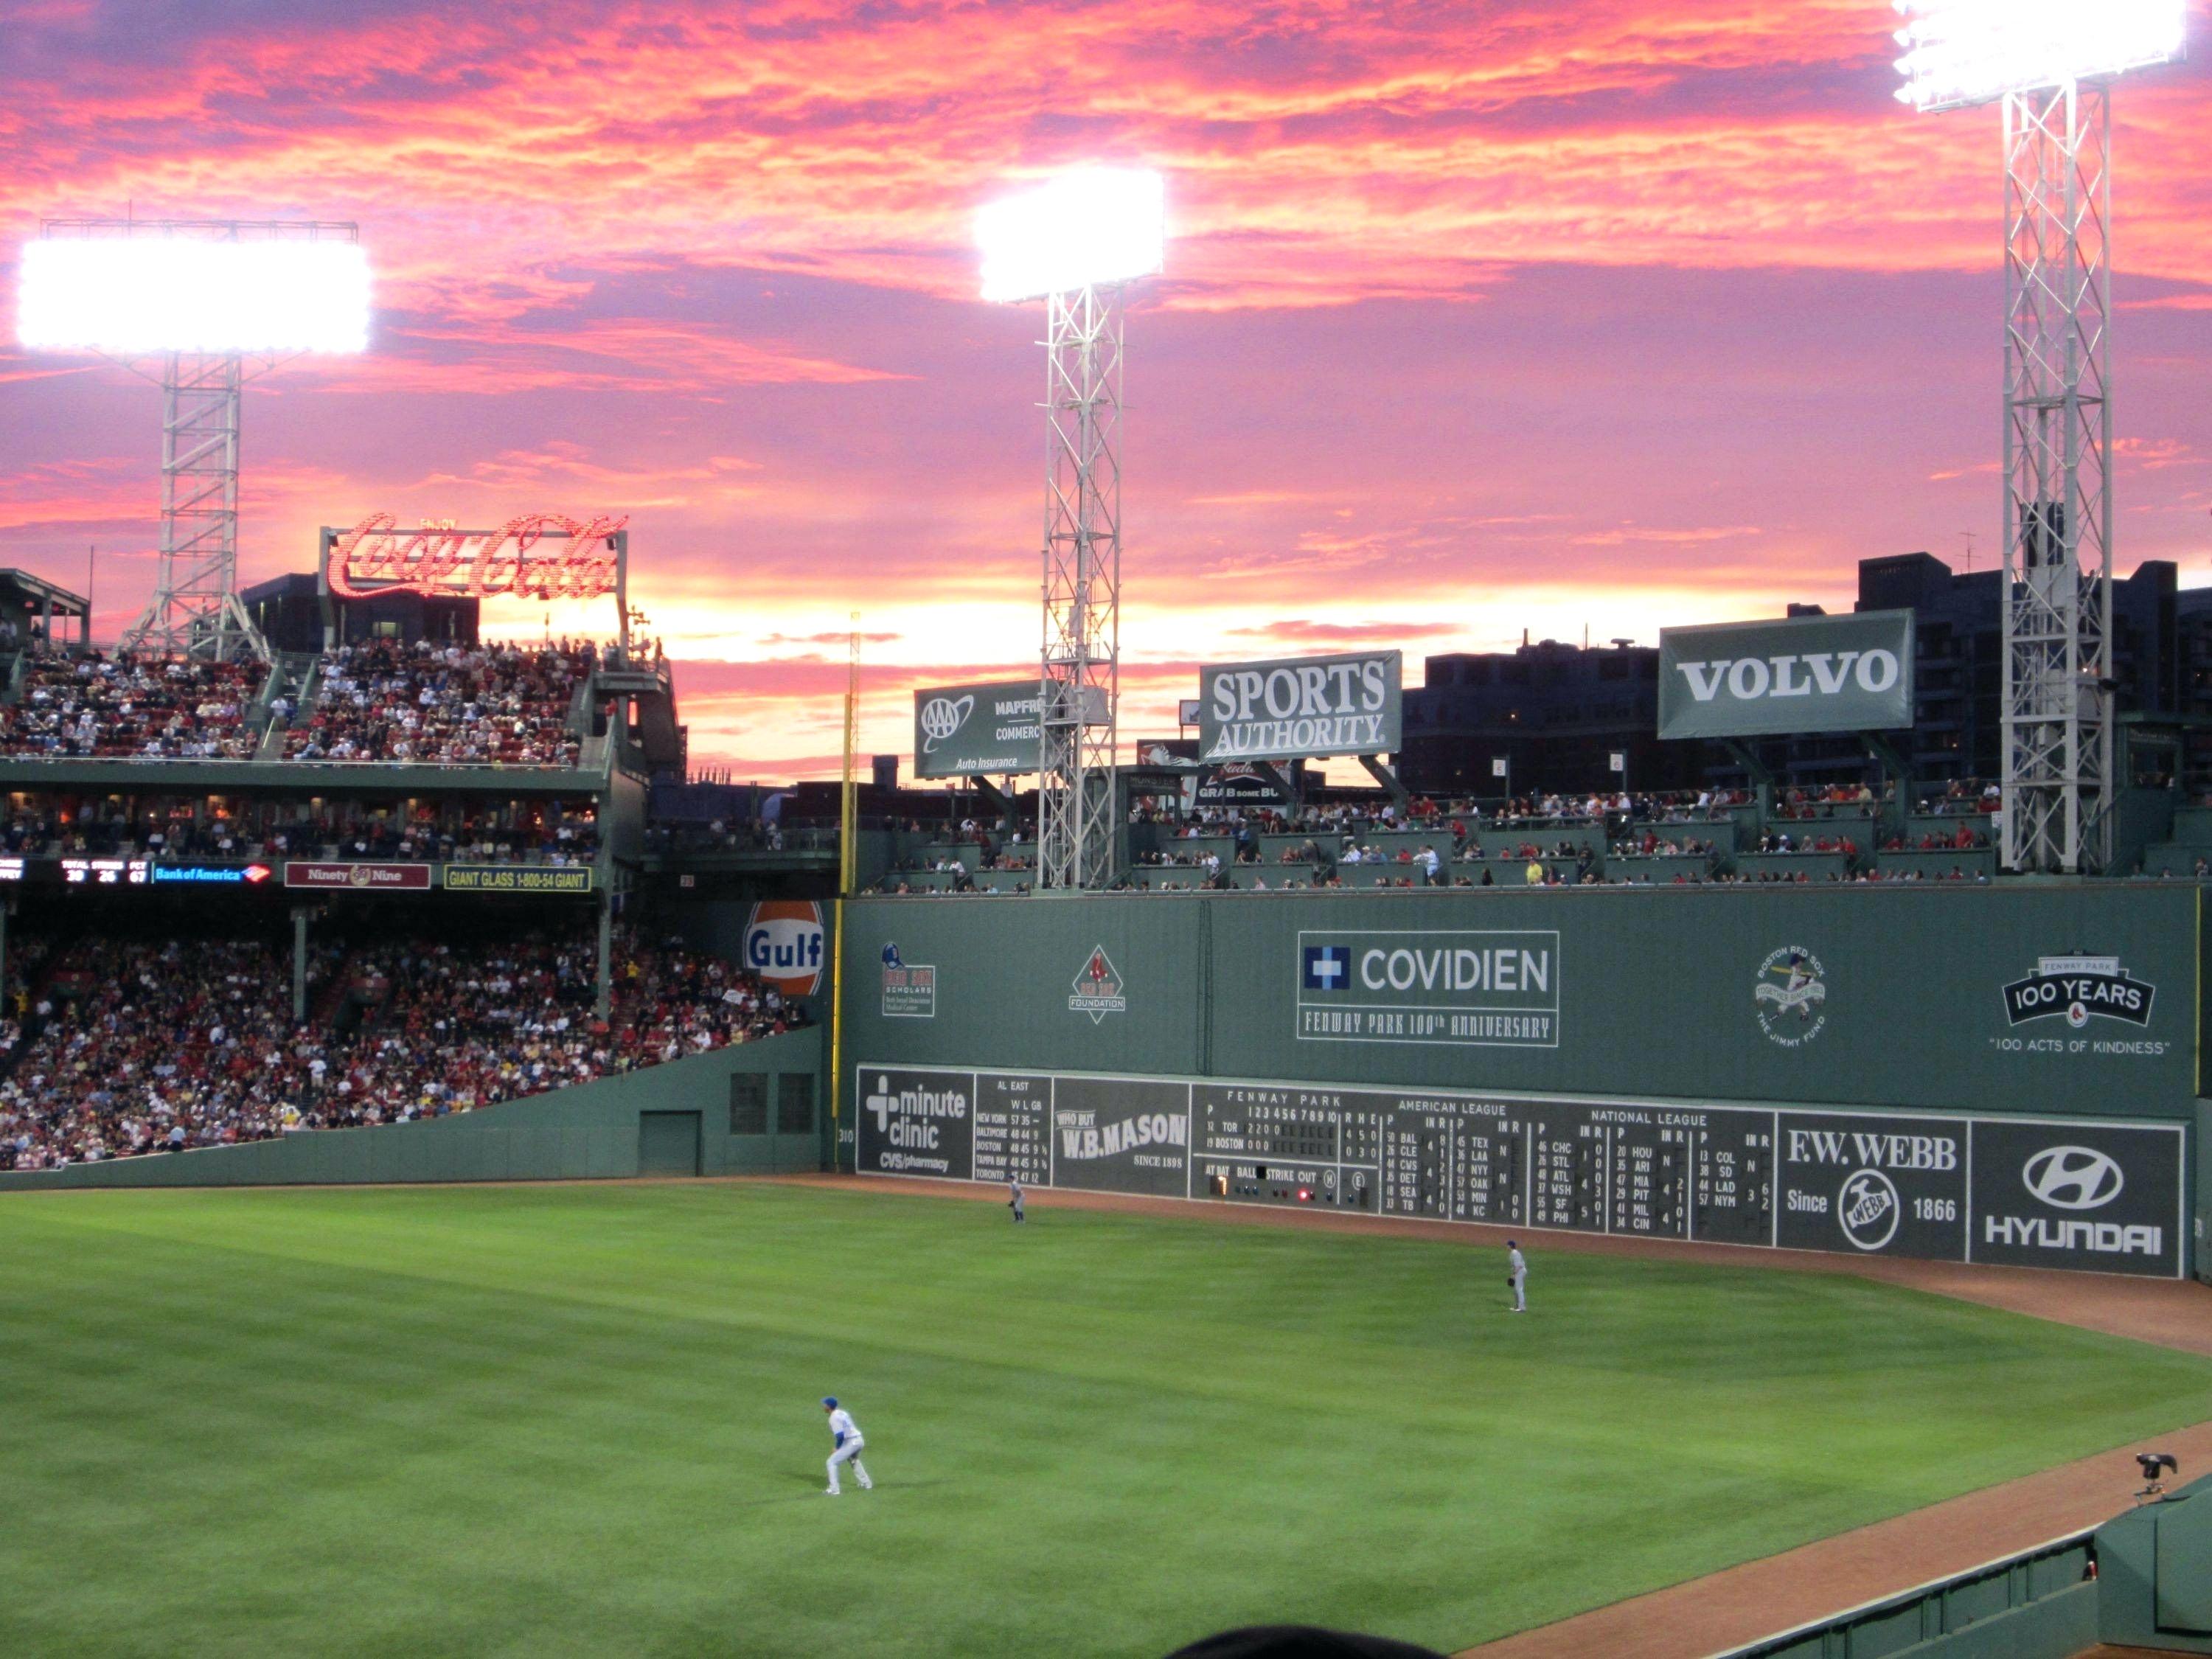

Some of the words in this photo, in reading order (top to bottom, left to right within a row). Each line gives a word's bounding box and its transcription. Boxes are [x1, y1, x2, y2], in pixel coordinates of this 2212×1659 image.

[420, 518, 458, 530] ENJOY
[327, 512, 628, 599] Coca-Cola
[1676, 649, 1898, 700] VOLVO
[1213, 661, 1385, 721] SPORTS
[926, 700, 956, 737] AAA
[956, 758, 976, 770] Auto
[978, 757, 1018, 768] Insurance
[1132, 777, 1176, 786] MONSTER
[1199, 787, 1236, 797] GRAB
[61, 860, 88, 869] TOTAL
[129, 861, 147, 869] PCT
[129, 871, 147, 883] 67
[156, 868, 182, 880] Bank
[184, 868, 195, 880] of
[195, 869, 240, 880] America
[308, 869, 348, 882] Ninety
[372, 870, 402, 881] Nine
[449, 871, 479, 885] GIANT
[481, 872, 514, 886] GLASS
[517, 872, 553, 887] 1-800-54
[555, 873, 585, 888] GIANT
[749, 930, 821, 967] Gulf
[1758, 947, 1787, 978] BOSTON
[1790, 945, 1808, 957] RED
[1809, 956, 1825, 977] SOX
[2085, 962, 2112, 970] PARK
[1361, 949, 1548, 992] COVIDIEN
[886, 970, 907, 986] RED
[912, 970, 932, 986] SOX
[1080, 983, 1096, 996] RED
[1099, 983, 1115, 996] SOX
[2016, 983, 2056, 1010] 100
[2062, 980, 2141, 1010] YEARS
[1071, 999, 1124, 1007] FOUNDATION
[1305, 1012, 1361, 1033] FENWAY
[1368, 1014, 1403, 1034] PARK
[1410, 1015, 1444, 1034] 100th
[1451, 1016, 1549, 1038] ANNIVERSARY
[1758, 1011, 1770, 1034] THE
[1770, 1034, 1800, 1047] JIMMY
[1804, 1016, 1825, 1042] FUND
[2028, 1040, 2063, 1051] ACTS
[2070, 1040, 2087, 1053] OF
[998, 1081, 1007, 1091] AL
[1011, 1082, 1029, 1091] EAST
[900, 1084, 966, 1119] minute
[1011, 1099, 1020, 1110] W
[1023, 1100, 1029, 1110] L
[1031, 1101, 1042, 1110] GB
[1228, 1091, 1288, 1104] FENWAY
[1301, 1095, 1340, 1107] PARK
[1399, 1100, 1456, 1113] AMERICAN
[1462, 1104, 1506, 1116] LEAGUE
[976, 1113, 989, 1123] NEW
[991, 1113, 1006, 1124] YORK
[1011, 1115, 1019, 1125] 57
[1021, 1115, 1030, 1126] 35
[1057, 1113, 1077, 1126] WHO
[1078, 1113, 1096, 1126] BUT
[1345, 1113, 1352, 1123] R
[1358, 1113, 1365, 1124] H
[1371, 1113, 1376, 1124] E
[1591, 1110, 1652, 1124] NATIONAL
[1658, 1114, 1707, 1126] LEAGUE
[1222, 1121, 1237, 1133] TOR
[1426, 1117, 1435, 1128] IN
[1439, 1117, 1445, 1129] R
[1498, 1121, 1507, 1133] IN
[1512, 1121, 1519, 1133] R
[838, 1128, 853, 1143] 310
[890, 1116, 939, 1150] clinic
[976, 1126, 1007, 1138] BALTIMORE
[1021, 1130, 1029, 1140] 44
[1033, 1130, 1039, 1140] 9
[1401, 1133, 1417, 1144] BAL
[1580, 1125, 1590, 1137] IN
[1594, 1126, 1601, 1138] R
[1661, 1130, 1672, 1142] IN
[1676, 1130, 1683, 1142] R
[1746, 1134, 1756, 1147] IN
[1761, 1135, 1769, 1147] R
[976, 1141, 1001, 1152] BOSTON
[1011, 1144, 1019, 1153] 48
[1021, 1144, 1029, 1154] 45
[1033, 1144, 1038, 1155] 9
[1216, 1138, 1244, 1150] BOSTON
[1472, 1137, 1488, 1148] TEX
[1552, 1141, 1571, 1154] CHC
[1400, 1147, 1417, 1157] CLE
[1471, 1151, 1488, 1162] LAA
[1632, 1147, 1652, 1158] HOU
[1787, 1130, 1848, 1165] F.W.
[1851, 1133, 1956, 1170] WEBB
[880, 1152, 949, 1173] CVS/pharmacy
[975, 1155, 994, 1166] TAMPA
[995, 1155, 1007, 1166] BAY
[1020, 1158, 1029, 1168] 45
[1033, 1158, 1038, 1169] 9
[1134, 1155, 1161, 1166] SINCE
[1163, 1158, 1182, 1169] 1898
[1553, 1155, 1570, 1168] STL
[1716, 1152, 1736, 1164] COL
[1399, 1160, 1417, 1170] CWS
[1470, 1165, 1488, 1176] NYY
[1635, 1161, 1649, 1172] ARI
[975, 1169, 1004, 1180] TORONTO
[1020, 1172, 1029, 1182] 47
[1206, 1165, 1215, 1175] AT
[1217, 1166, 1230, 1176] BAT
[1237, 1166, 1256, 1178] BALL
[1266, 1168, 1294, 1182] STRIKE
[1298, 1171, 1316, 1183] OUT
[1399, 1173, 1416, 1184] DET
[1553, 1170, 1569, 1182] ATL
[1719, 1166, 1733, 1178] SD
[1470, 1178, 1488, 1189] OAK
[1634, 1175, 1649, 1187] MIA
[1715, 1181, 1736, 1193] LAD
[1399, 1187, 1416, 1197] SEA
[1551, 1184, 1571, 1195] WSH
[1633, 1189, 1649, 1201] PIT
[1472, 1192, 1487, 1203] MIN
[1555, 1198, 1568, 1209] SF
[1714, 1194, 1736, 1207] NYM
[1402, 1200, 1413, 1211] TB
[1473, 1206, 1485, 1217] KC
[1633, 1204, 1649, 1216] MIL
[1787, 1189, 1827, 1213] Since
[1914, 1197, 1955, 1221] 1866
[1853, 1194, 1885, 1222] WEBB
[1554, 1211, 1568, 1223] PHI
[1633, 1218, 1649, 1229] CIN
[1986, 1215, 2161, 1255] HYUNDAI
